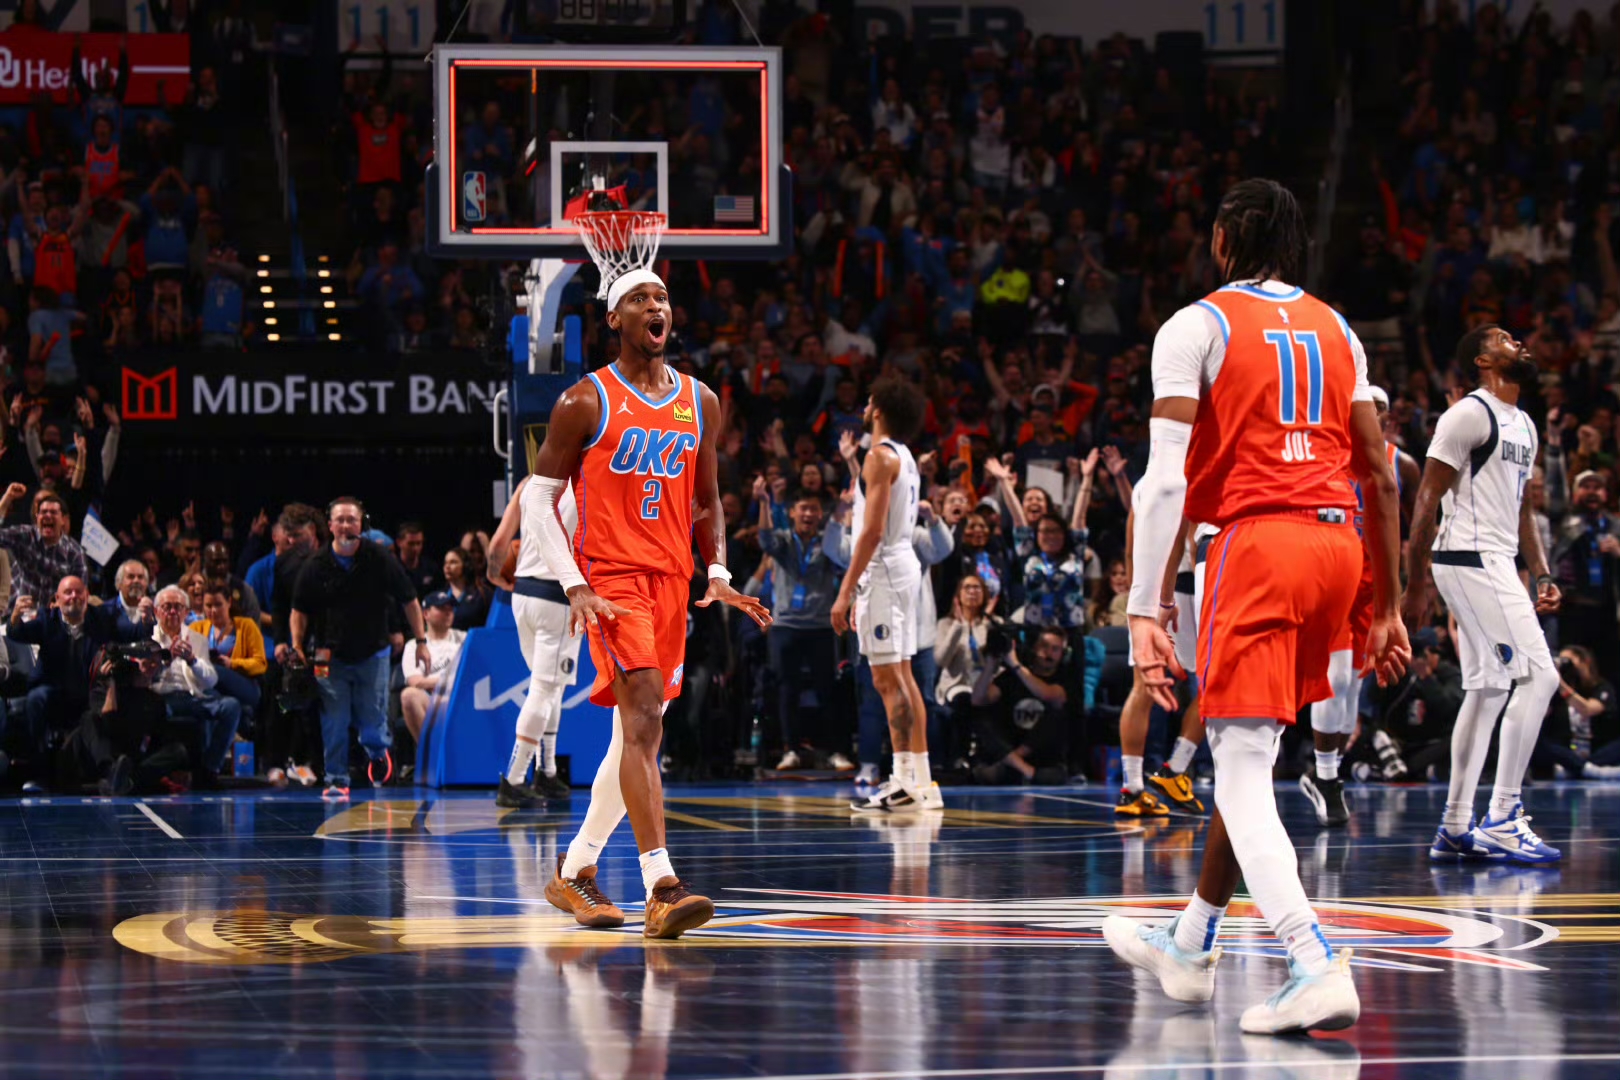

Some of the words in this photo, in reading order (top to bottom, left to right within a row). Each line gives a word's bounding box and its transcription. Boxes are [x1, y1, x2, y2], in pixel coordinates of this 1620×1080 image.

[348, 5, 419, 47] 111
[1204, 2, 1276, 44] 111
[1263, 329, 1324, 425] 11
[609, 426, 697, 479] OKC
[1281, 430, 1316, 463] JOE
[1502, 440, 1531, 468] DALLAS
[640, 478, 662, 519] 2
